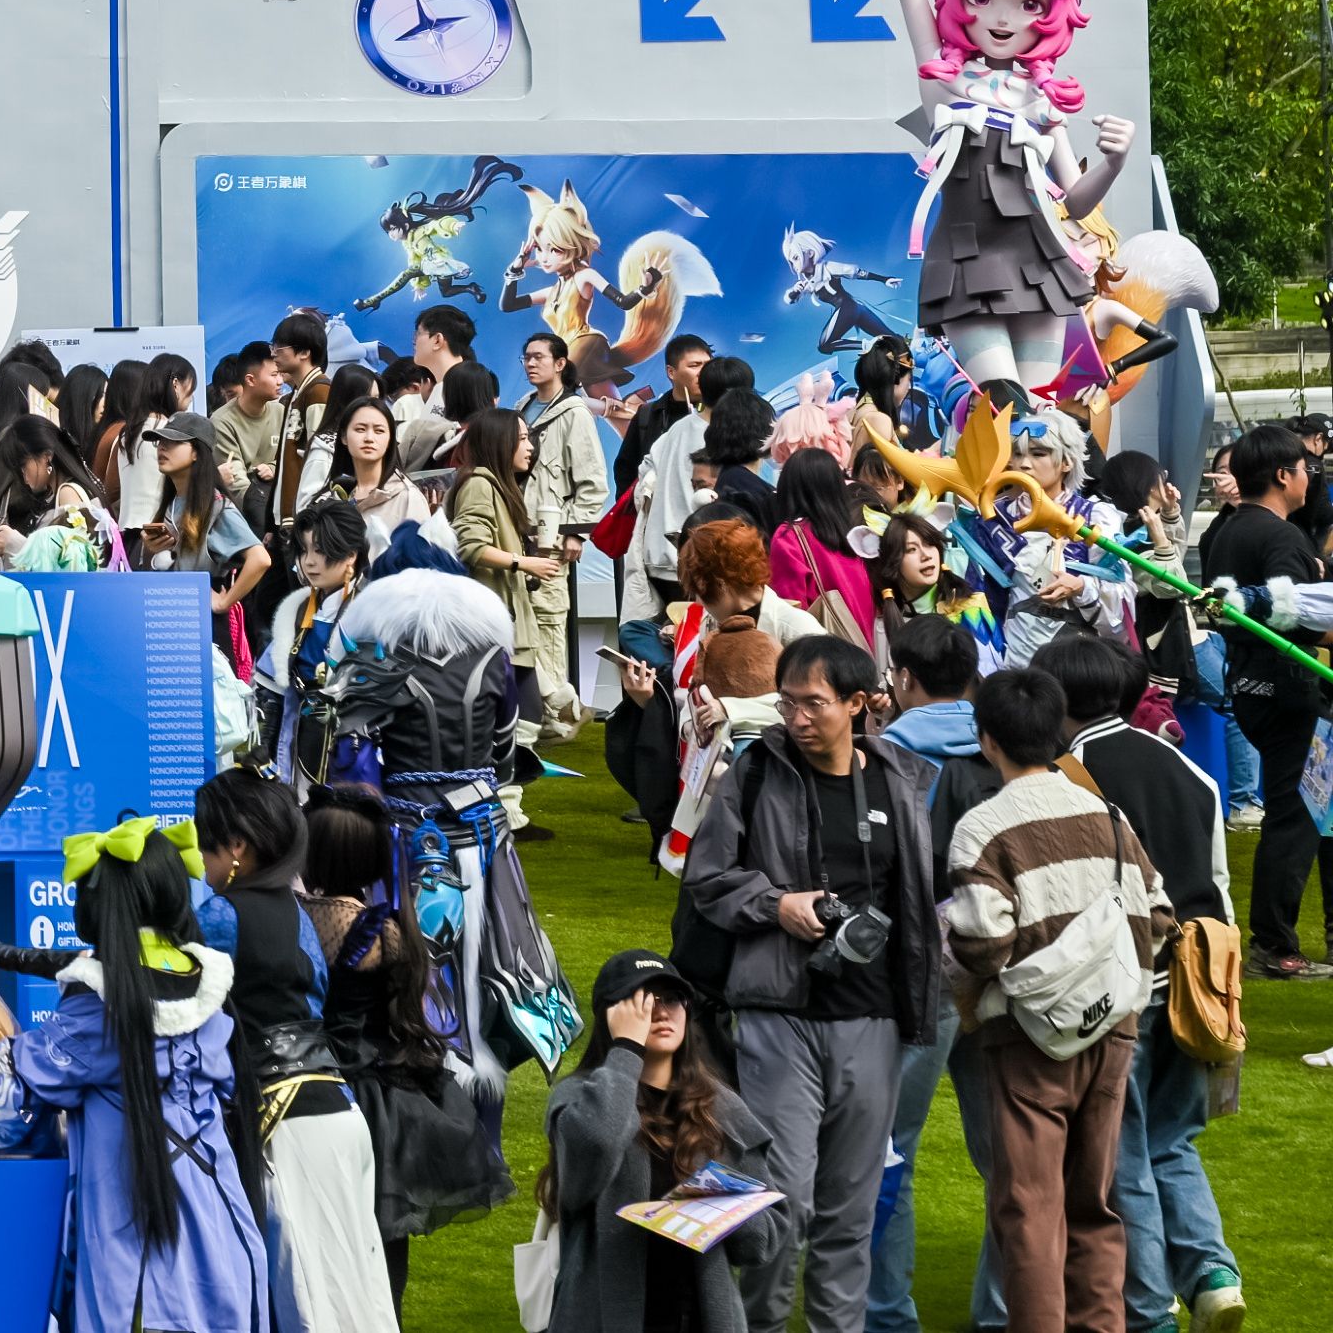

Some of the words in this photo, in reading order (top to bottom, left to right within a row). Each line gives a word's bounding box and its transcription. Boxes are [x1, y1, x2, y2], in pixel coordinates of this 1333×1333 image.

[237, 175, 307, 189] 王者万象棋
[1083, 993, 1110, 1027] NIKE
